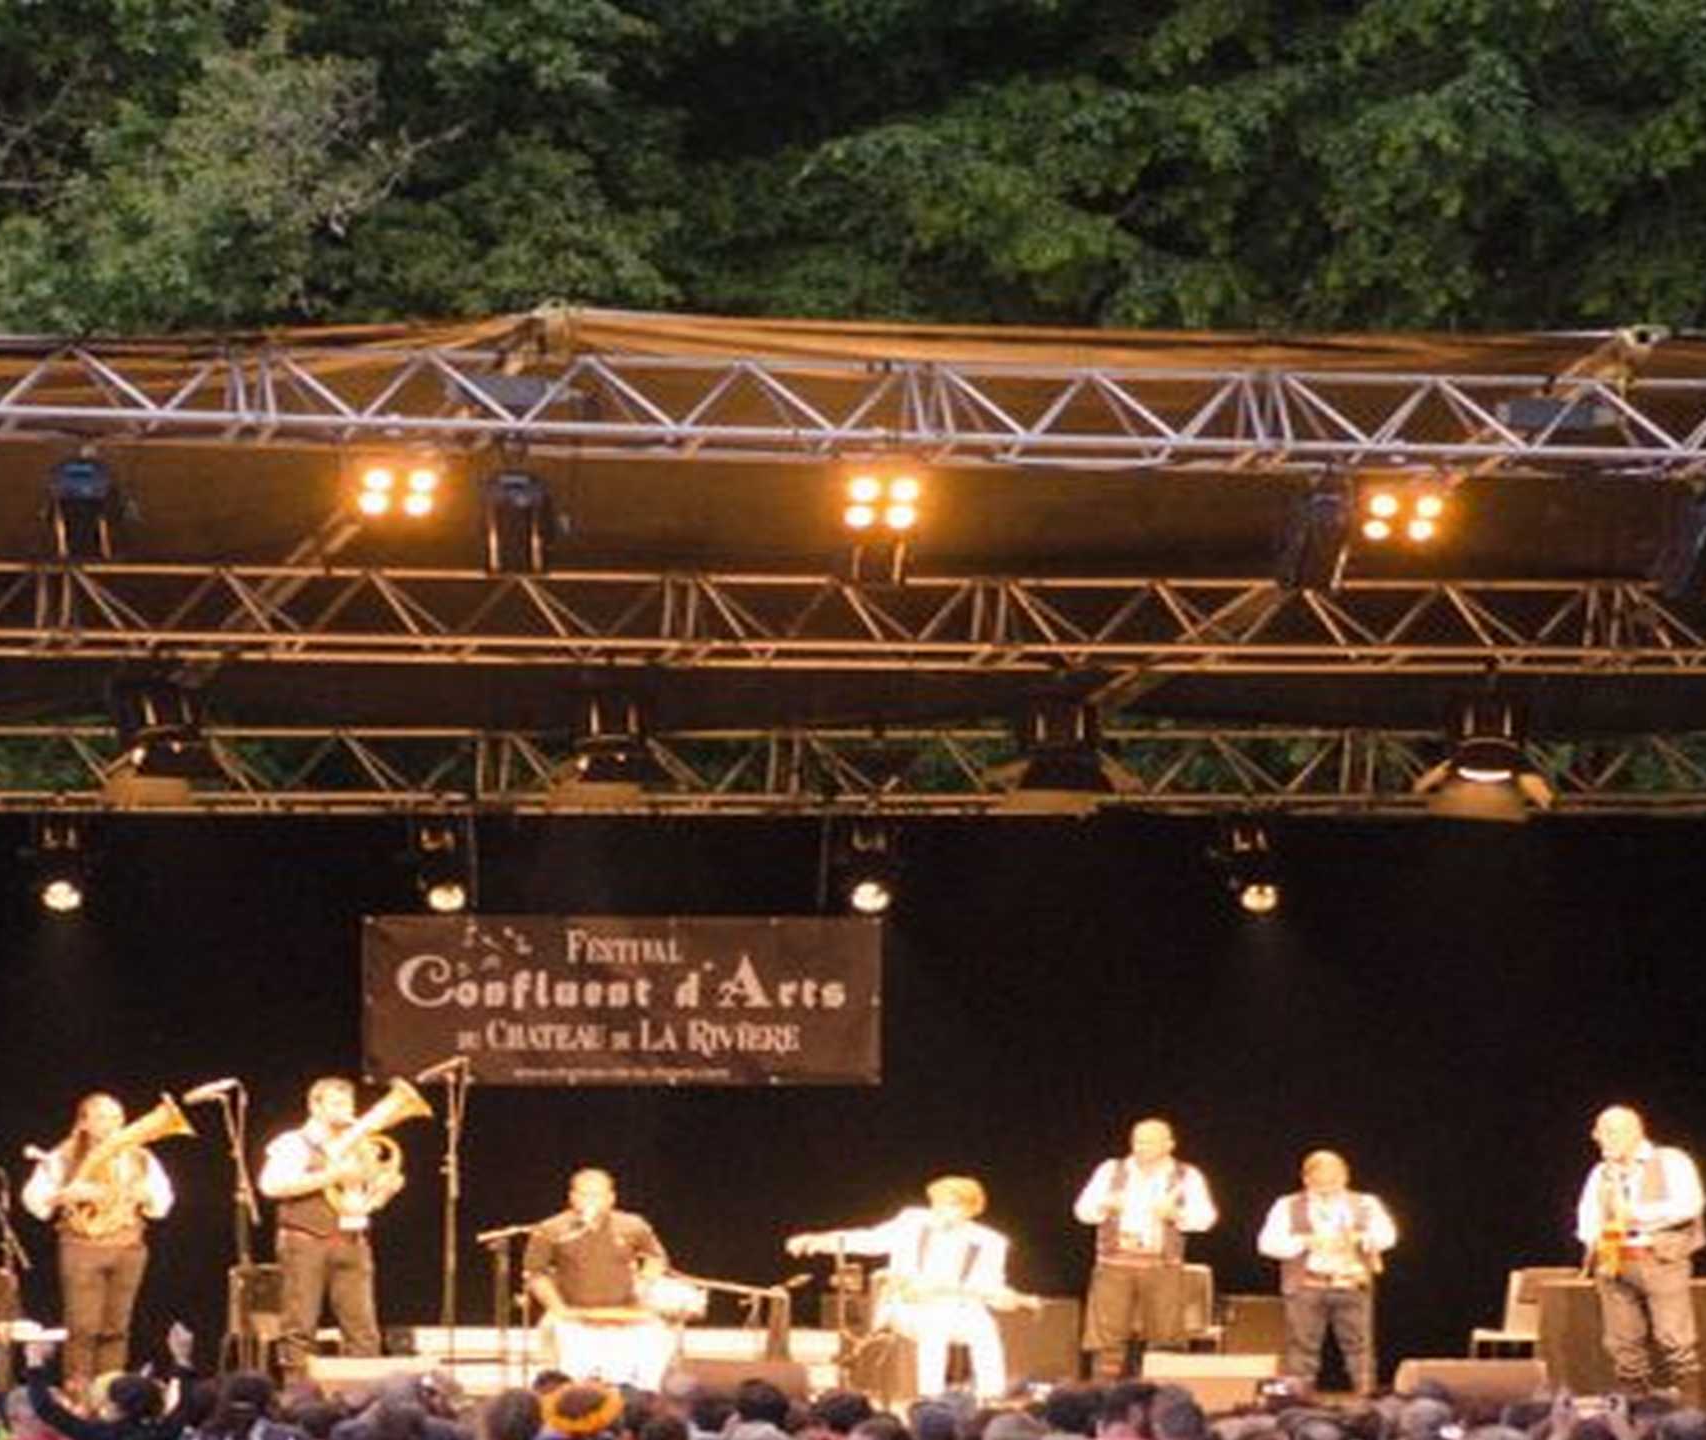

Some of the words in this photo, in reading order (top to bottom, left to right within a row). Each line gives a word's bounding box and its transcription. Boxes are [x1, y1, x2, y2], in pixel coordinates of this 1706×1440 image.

[566, 929, 684, 964] FESTIVAL
[396, 954, 651, 1010] Confluent
[674, 953, 846, 1009] d'Arts
[640, 1018, 679, 1051] LA
